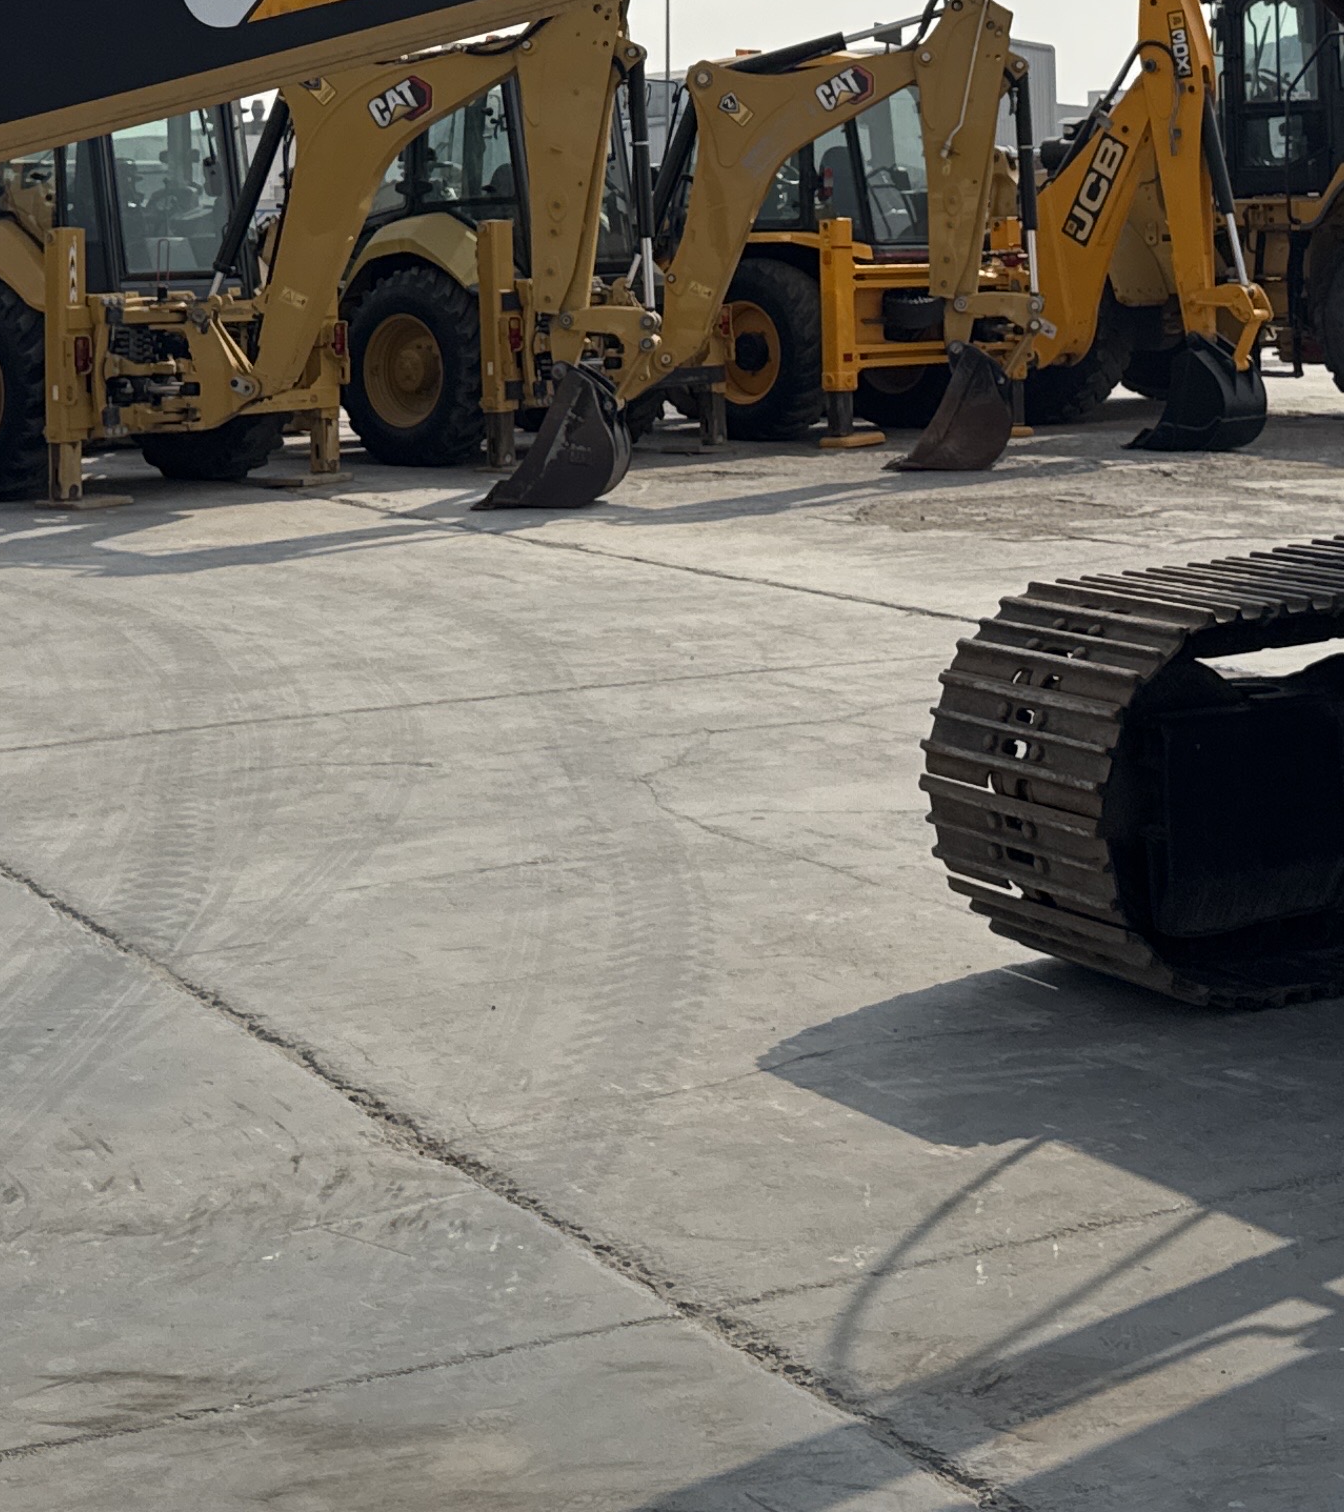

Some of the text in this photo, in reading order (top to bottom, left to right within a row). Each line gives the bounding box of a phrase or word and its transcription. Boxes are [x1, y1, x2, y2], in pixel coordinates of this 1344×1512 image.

[368, 79, 419, 127] CAT
[816, 68, 861, 110] CAT
[1072, 137, 1125, 241] JCB
